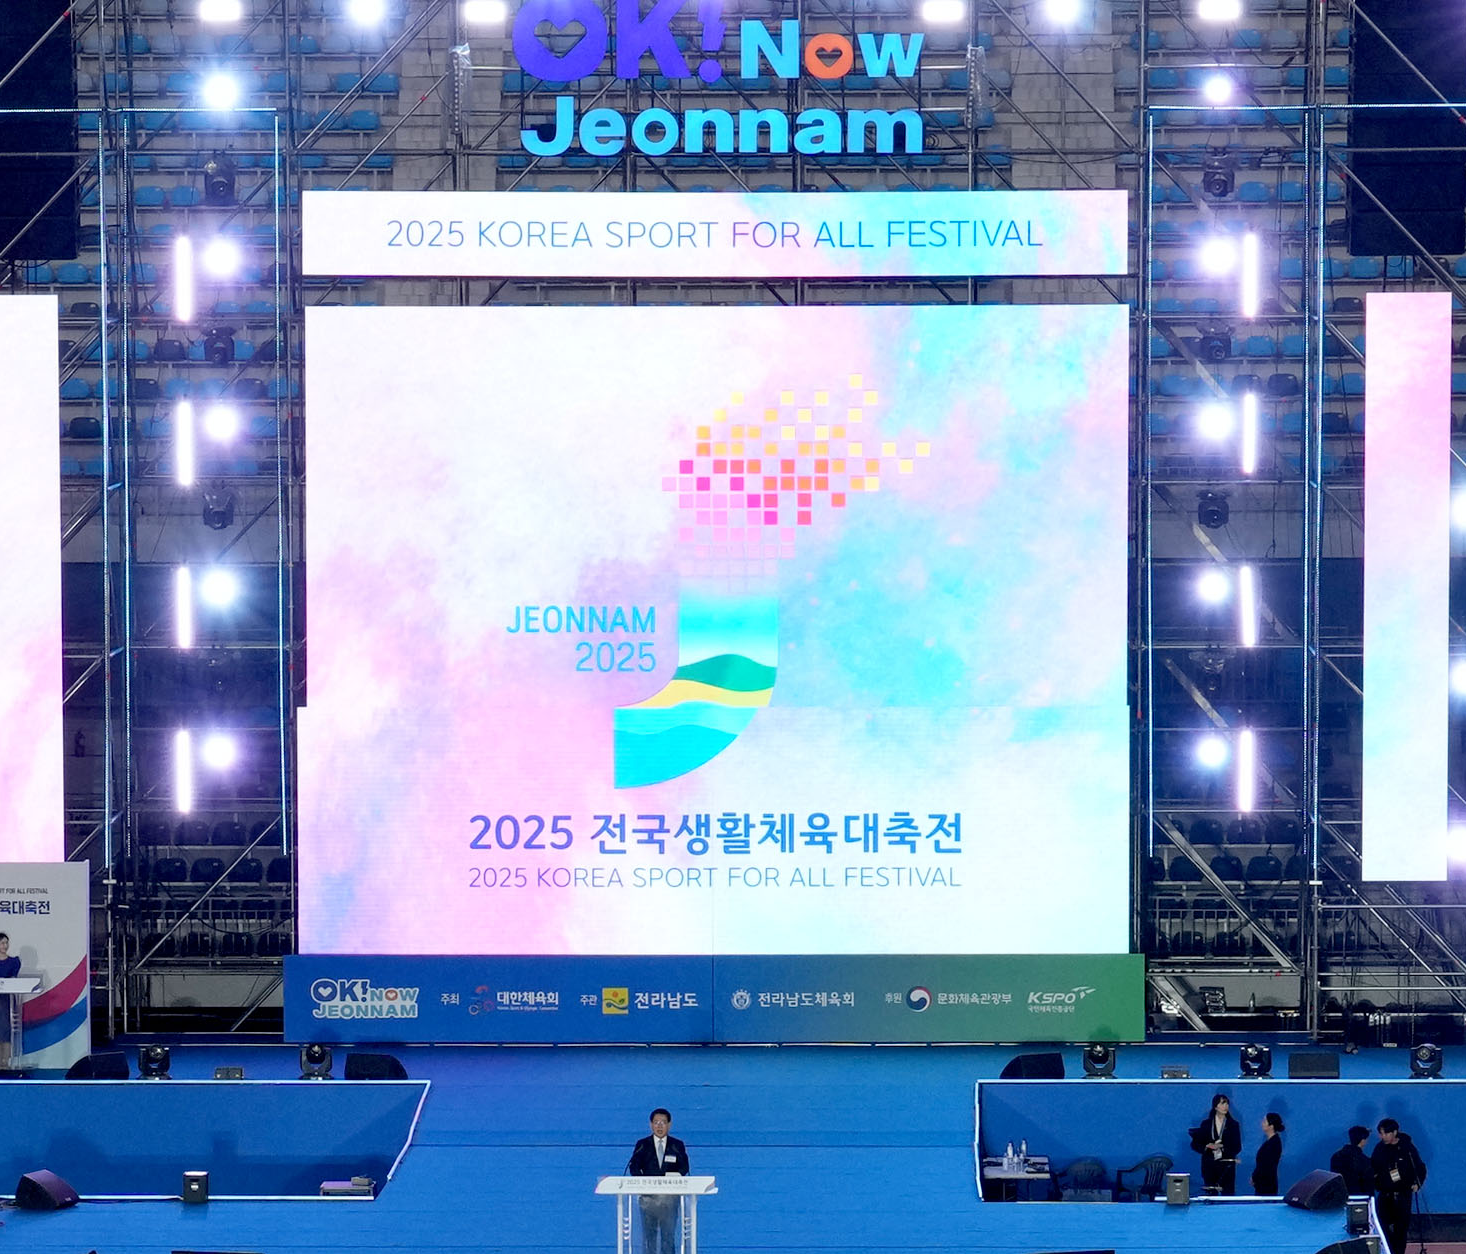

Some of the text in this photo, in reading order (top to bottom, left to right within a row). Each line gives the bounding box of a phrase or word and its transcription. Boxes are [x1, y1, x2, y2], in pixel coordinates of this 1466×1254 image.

[513, 0, 925, 84] OK! Now
[520, 96, 925, 157] Jeonnam
[386, 219, 1043, 250] 2025 KOREA SPORT FOR ALL FESTIVAL
[507, 605, 656, 634] JEONNAM
[575, 641, 656, 672] 2025
[469, 811, 963, 856] 2025 전국생활체육대축전
[468, 866, 962, 888] 2025 KOREA SPORT FOR ALL FESTIVAL
[311, 978, 419, 1004] OK! NOW
[440, 993, 460, 1006] 주최
[496, 991, 559, 1006] 대한체육회
[580, 993, 597, 1007] 주관
[634, 991, 699, 1009] 전라남도
[757, 991, 855, 1008] 전라남도체육회
[937, 992, 1012, 1006] 문화체육관광부
[1028, 991, 1076, 1004] KSPO
[312, 1002, 419, 1019] JEONNAM
